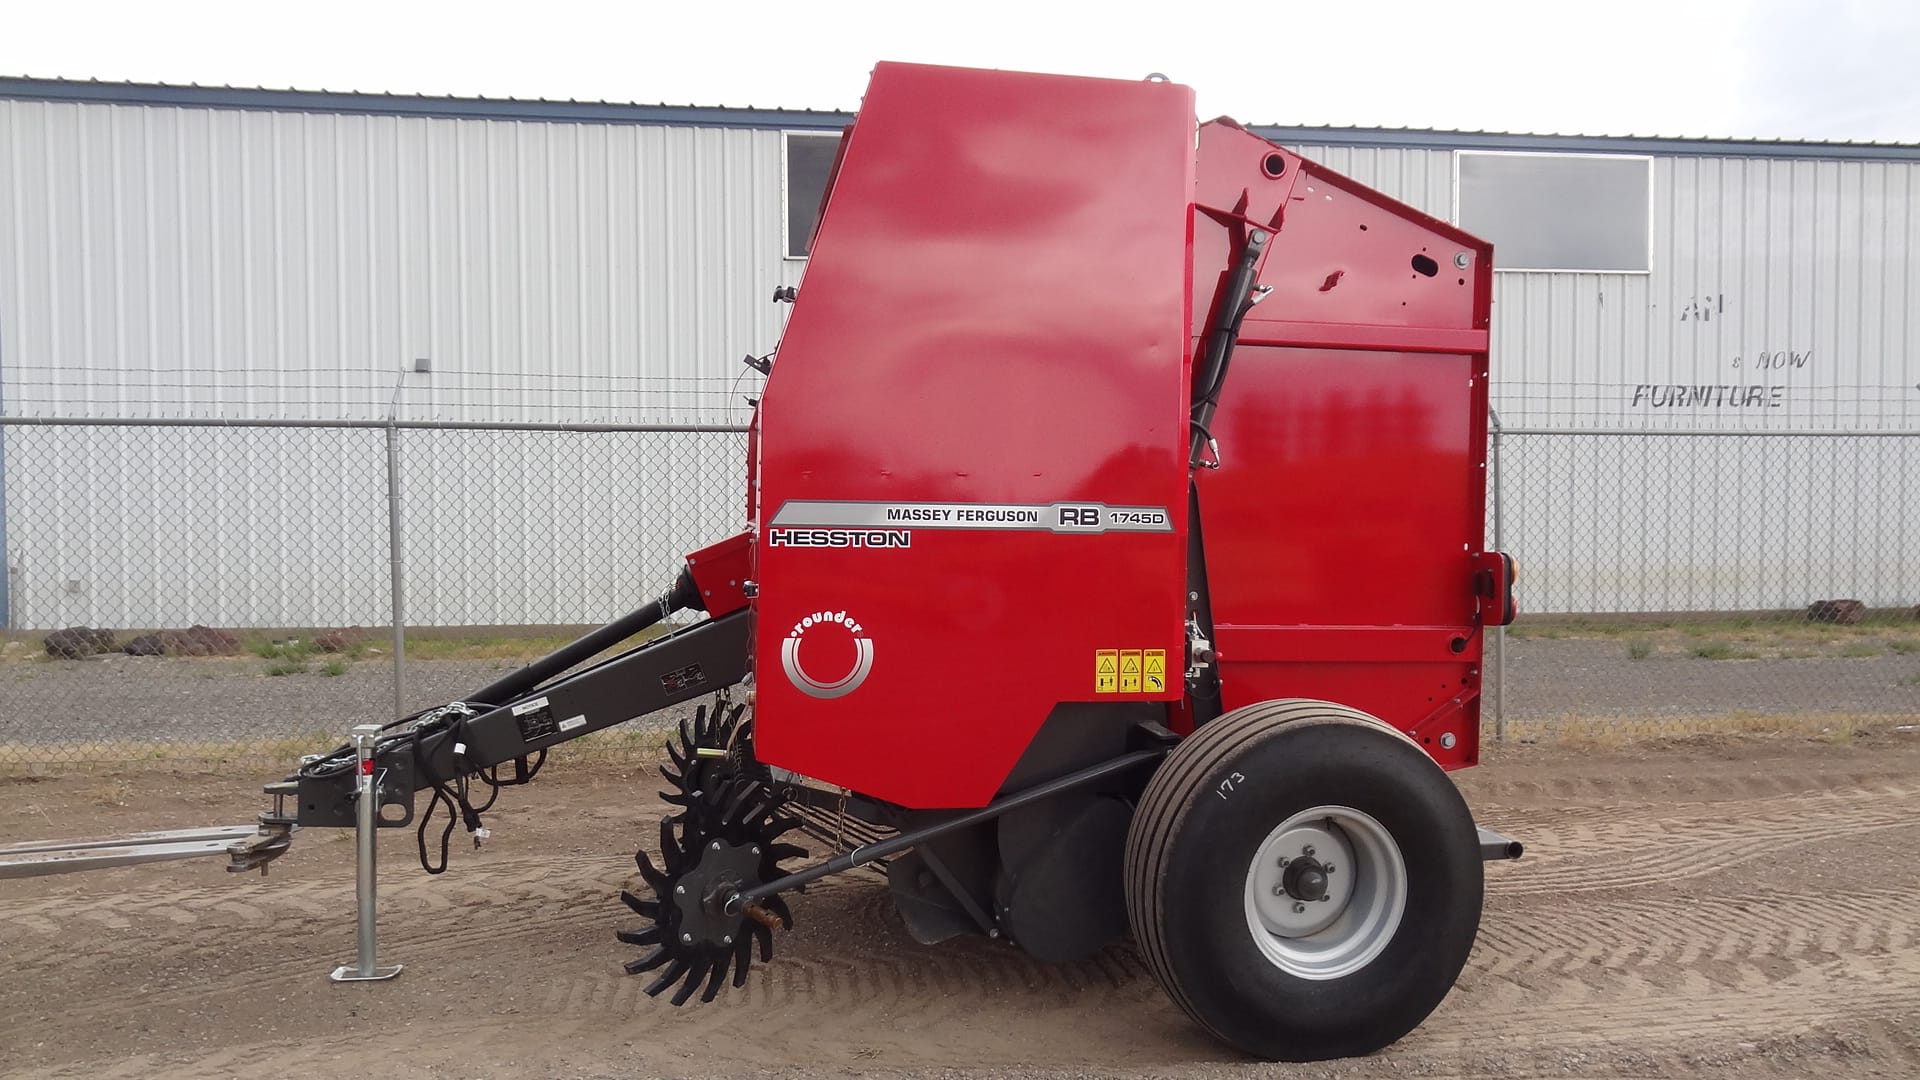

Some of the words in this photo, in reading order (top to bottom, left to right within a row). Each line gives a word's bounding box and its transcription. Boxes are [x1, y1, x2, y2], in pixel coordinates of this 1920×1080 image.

[1756, 351, 1812, 369] NOW
[1632, 385, 1785, 407] FURNITURE
[887, 508, 952, 521] MASSEY
[957, 509, 1038, 522] FERGUSON
[1059, 508, 1100, 526] RB
[1110, 513, 1165, 524] 1745D
[770, 530, 910, 547] HESSTON
[1216, 771, 1245, 800] 173
